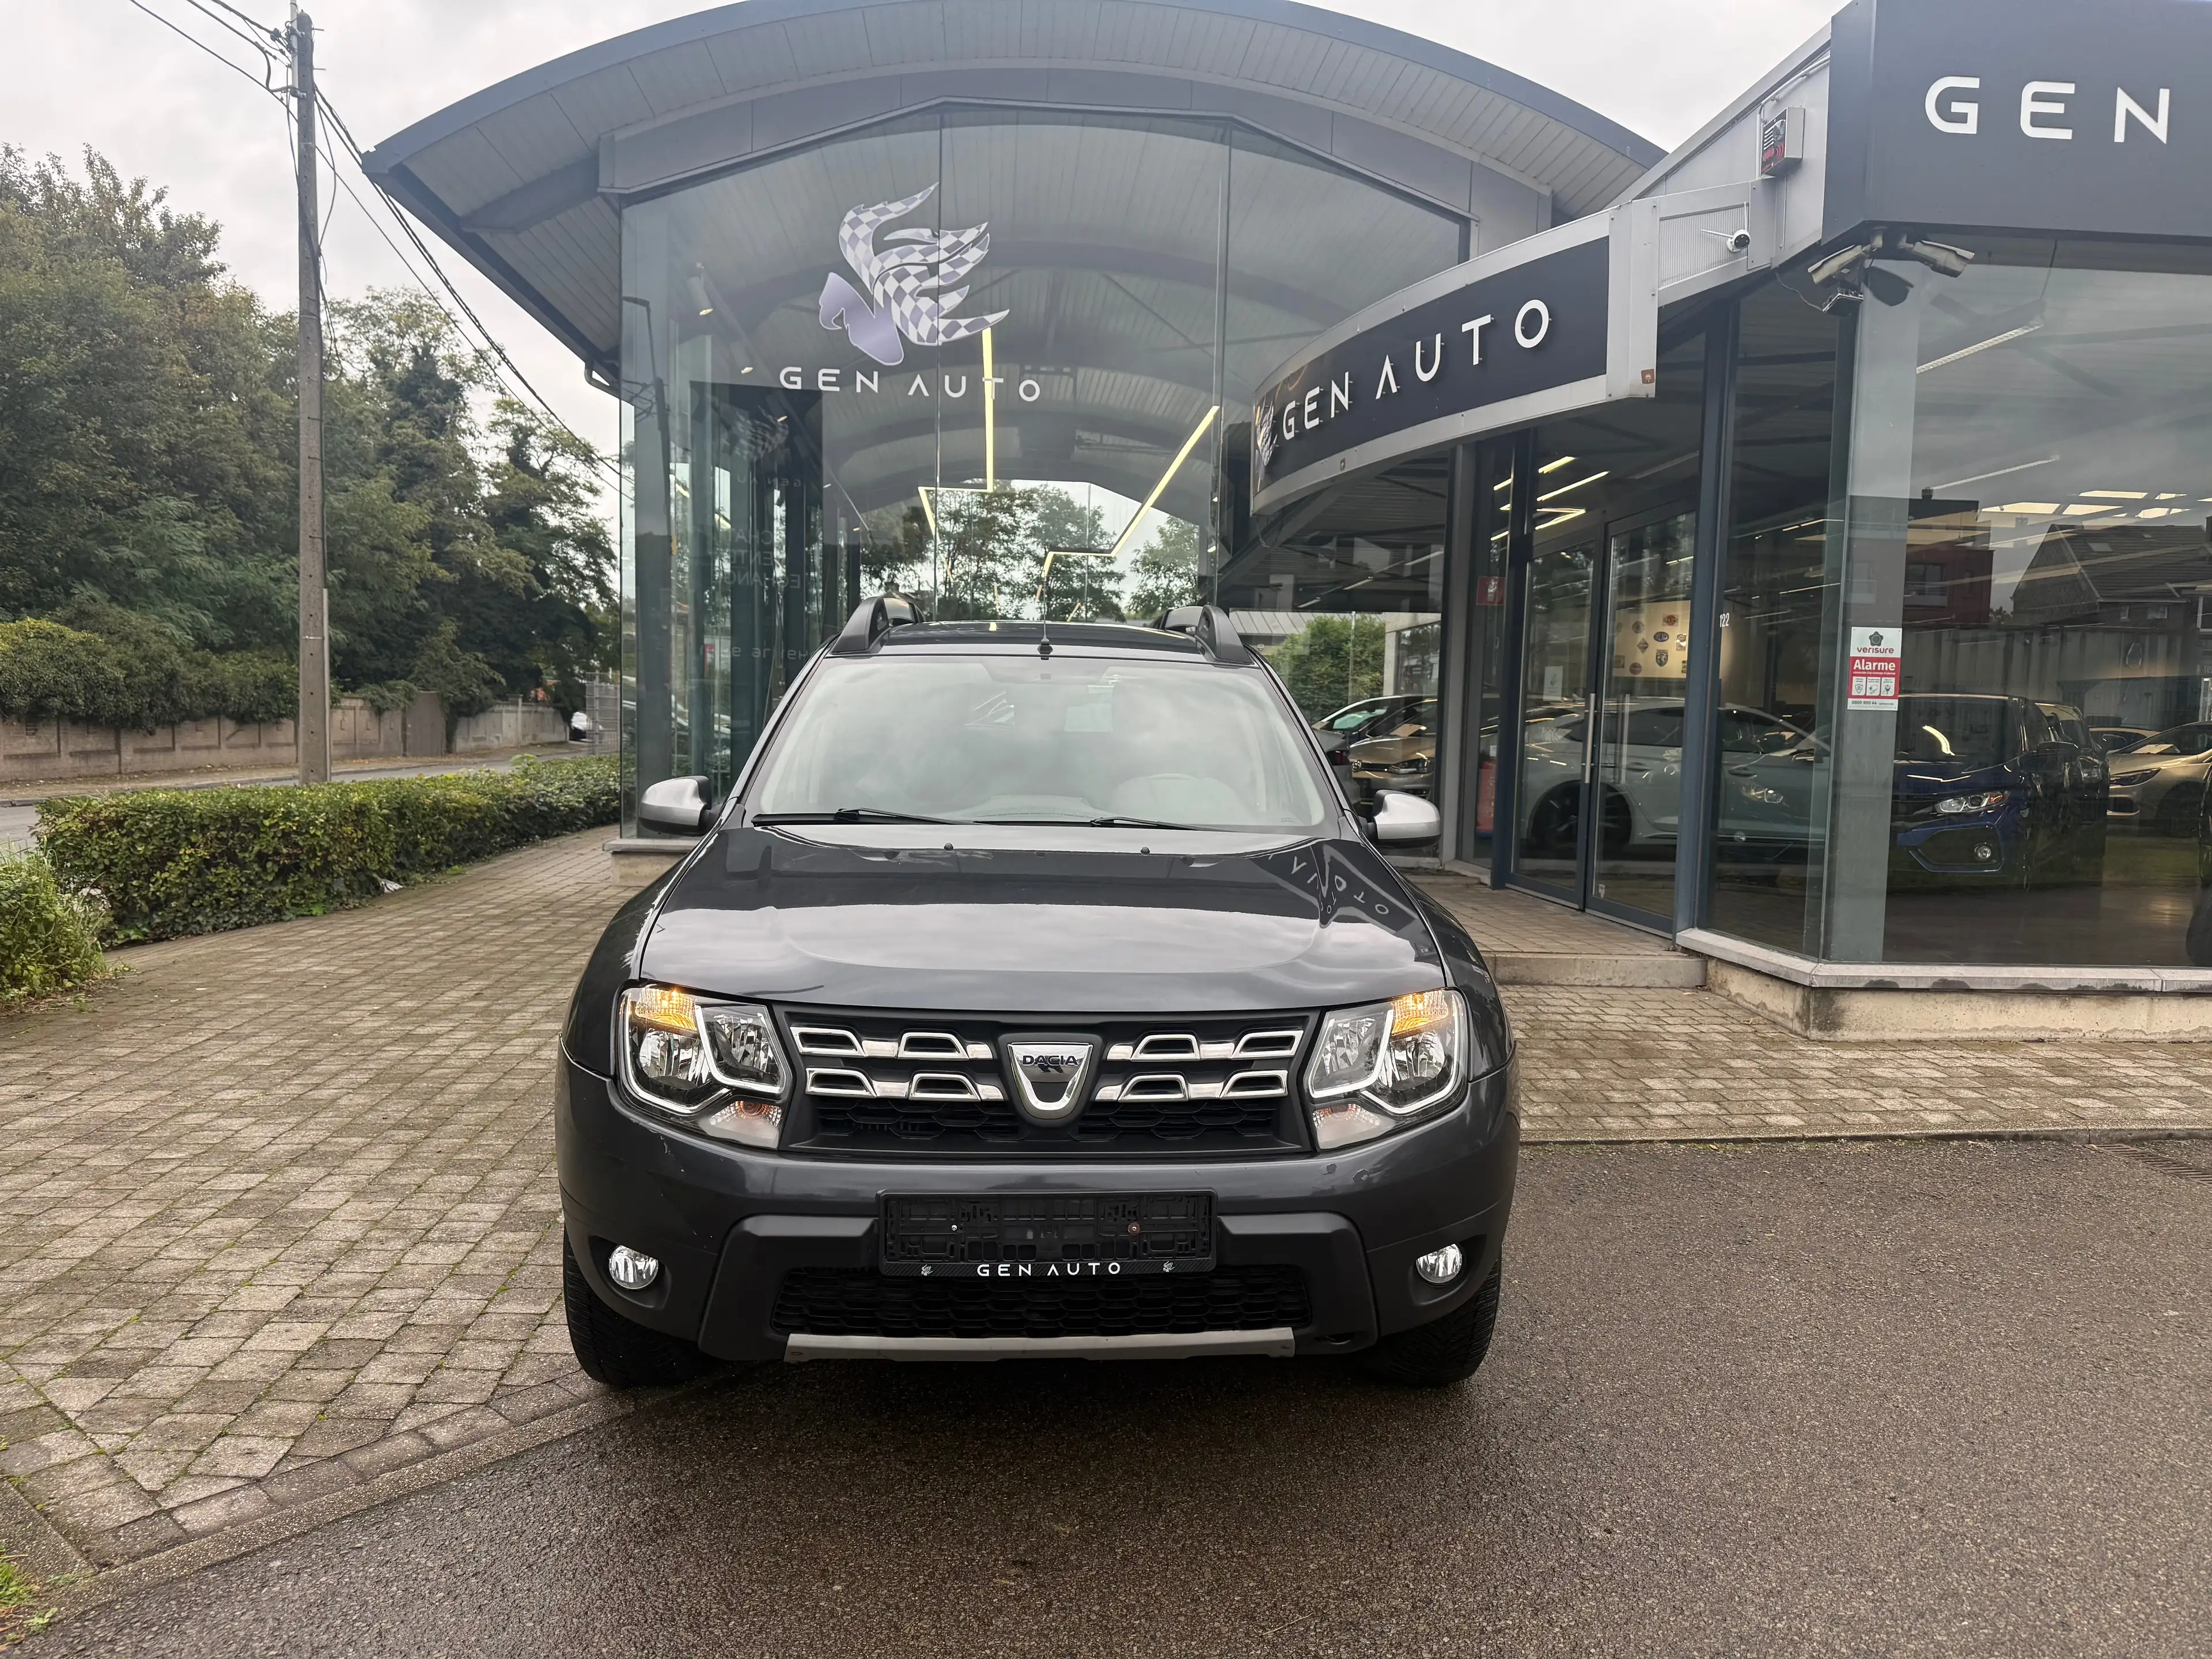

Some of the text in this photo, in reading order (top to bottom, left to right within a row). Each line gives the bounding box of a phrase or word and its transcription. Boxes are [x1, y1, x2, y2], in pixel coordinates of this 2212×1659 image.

[1925, 75, 2170, 145] GEN
[1282, 298, 1550, 441] GEN AUTO
[779, 366, 1040, 402] GEN AUTO
[1719, 612, 1730, 628] 122
[1853, 658, 1896, 671] Alarme
[1022, 1055, 1078, 1066] DACIA
[977, 1262, 1121, 1277] GEN AUTO
